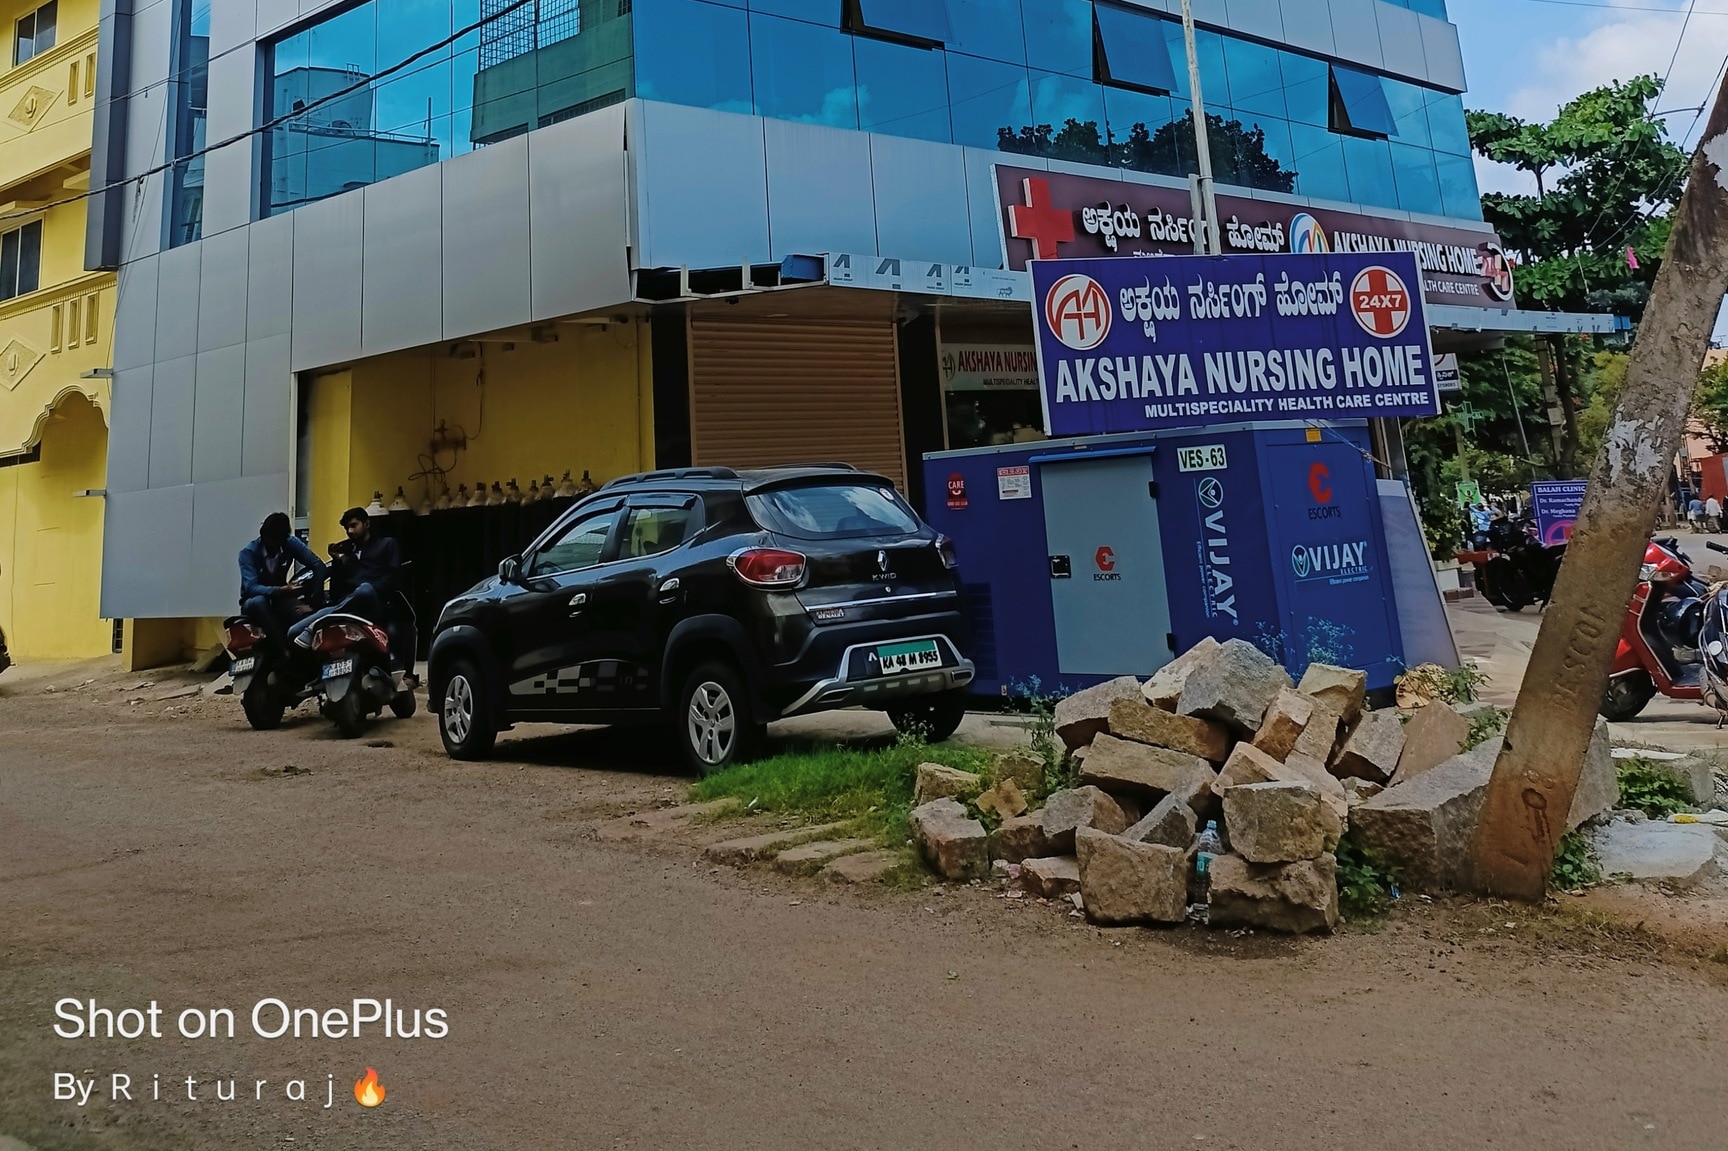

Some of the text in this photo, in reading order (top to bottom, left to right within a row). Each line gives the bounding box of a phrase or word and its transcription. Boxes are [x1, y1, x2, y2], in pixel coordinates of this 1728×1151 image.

[1082, 200, 1141, 252] ಅಕ್ಷಯ
[1226, 214, 1285, 253] ಹೋಮ್
[1444, 245, 1483, 275] HOME
[1423, 279, 1480, 296] LTH CARE CENTRE
[1119, 270, 1344, 343] ಅಕ್ಷಯ ನರ್ಸಿಂಗ್ ಹೋಮ್
[958, 351, 1038, 372] AKSHAYA NURSIN
[1024, 378, 1040, 386] HEALT
[1056, 345, 1426, 403] AKSHAYA NURSING HOME
[1144, 391, 1429, 418] MULTISPECIALITY HEALTH CARE CENTRE
[948, 480, 965, 489] CARE
[1308, 505, 1342, 520] ESCORTS
[1205, 509, 1238, 618] VIJAY
[1308, 541, 1364, 572] VIJAY
[872, 572, 897, 581] KWID
[1093, 573, 1122, 581] ESCORTS
[1206, 564, 1218, 618] ELECTRIC
[882, 656, 894, 669] KA
[919, 650, 939, 664] 8955
